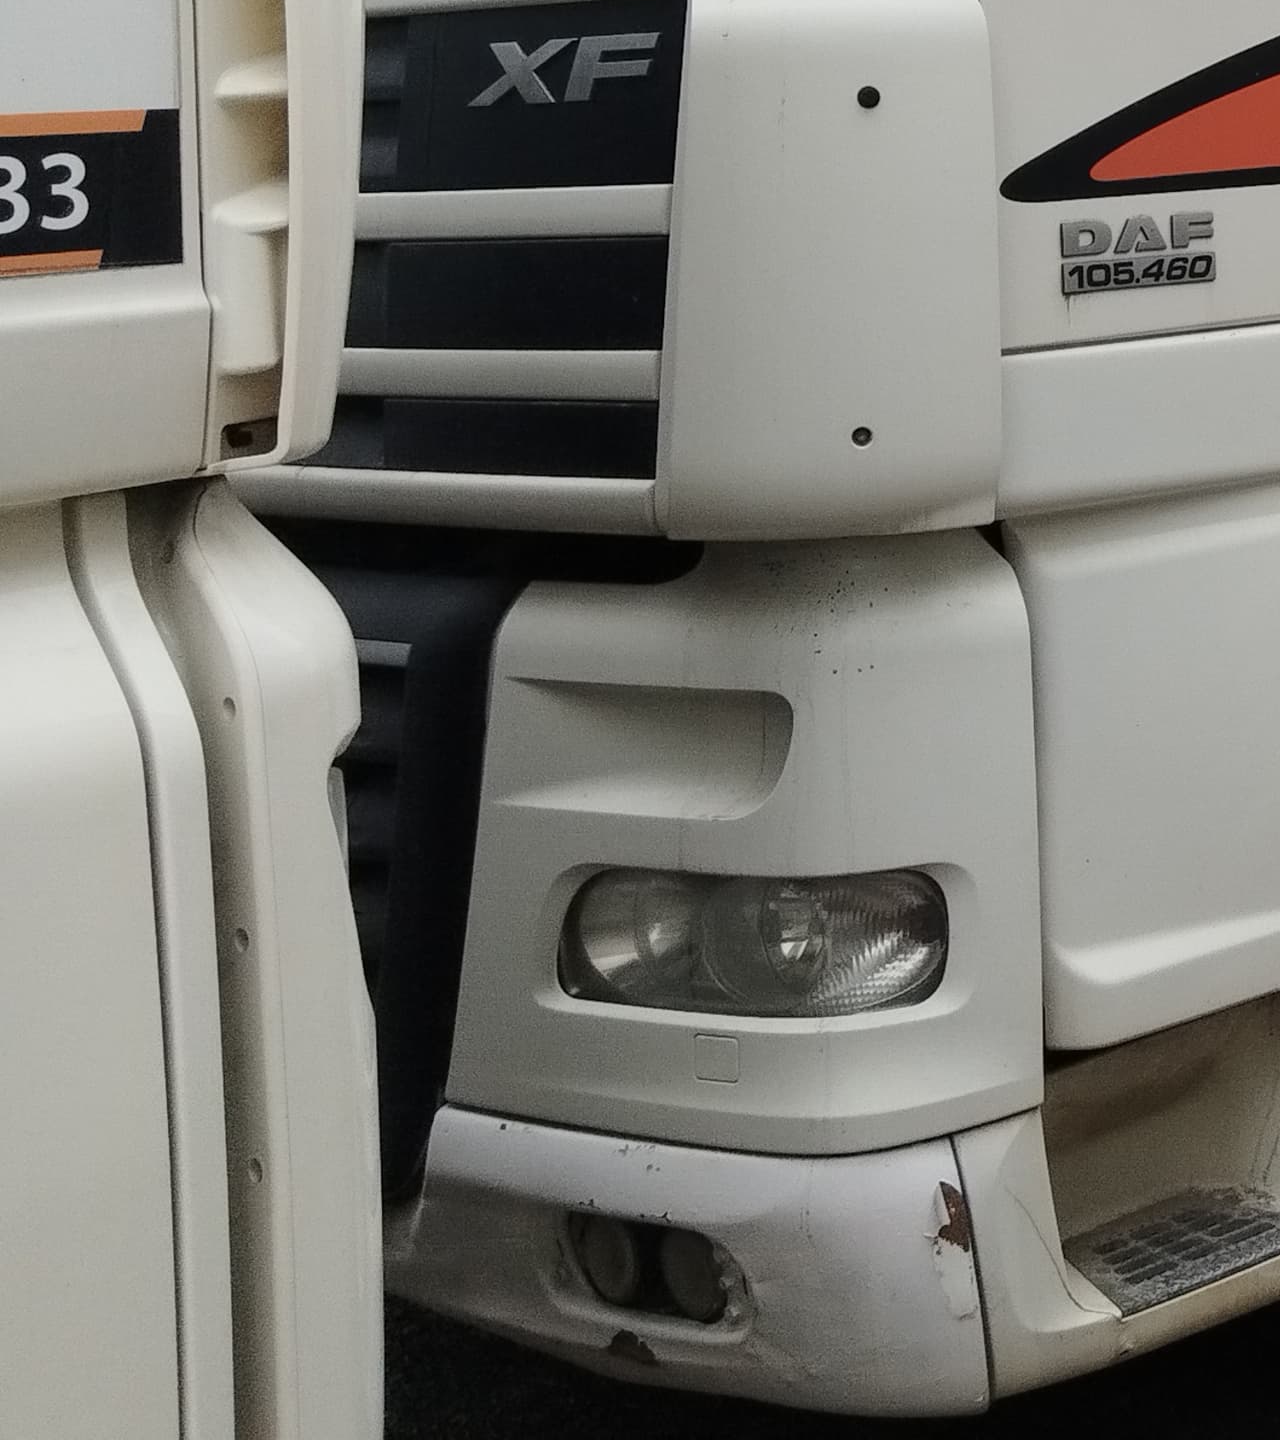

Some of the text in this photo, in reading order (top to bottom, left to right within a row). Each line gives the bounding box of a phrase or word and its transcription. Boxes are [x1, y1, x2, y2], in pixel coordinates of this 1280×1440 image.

[466, 32, 662, 106] XF
[1060, 211, 1214, 258] DAF
[1068, 255, 1213, 288] 105.460
